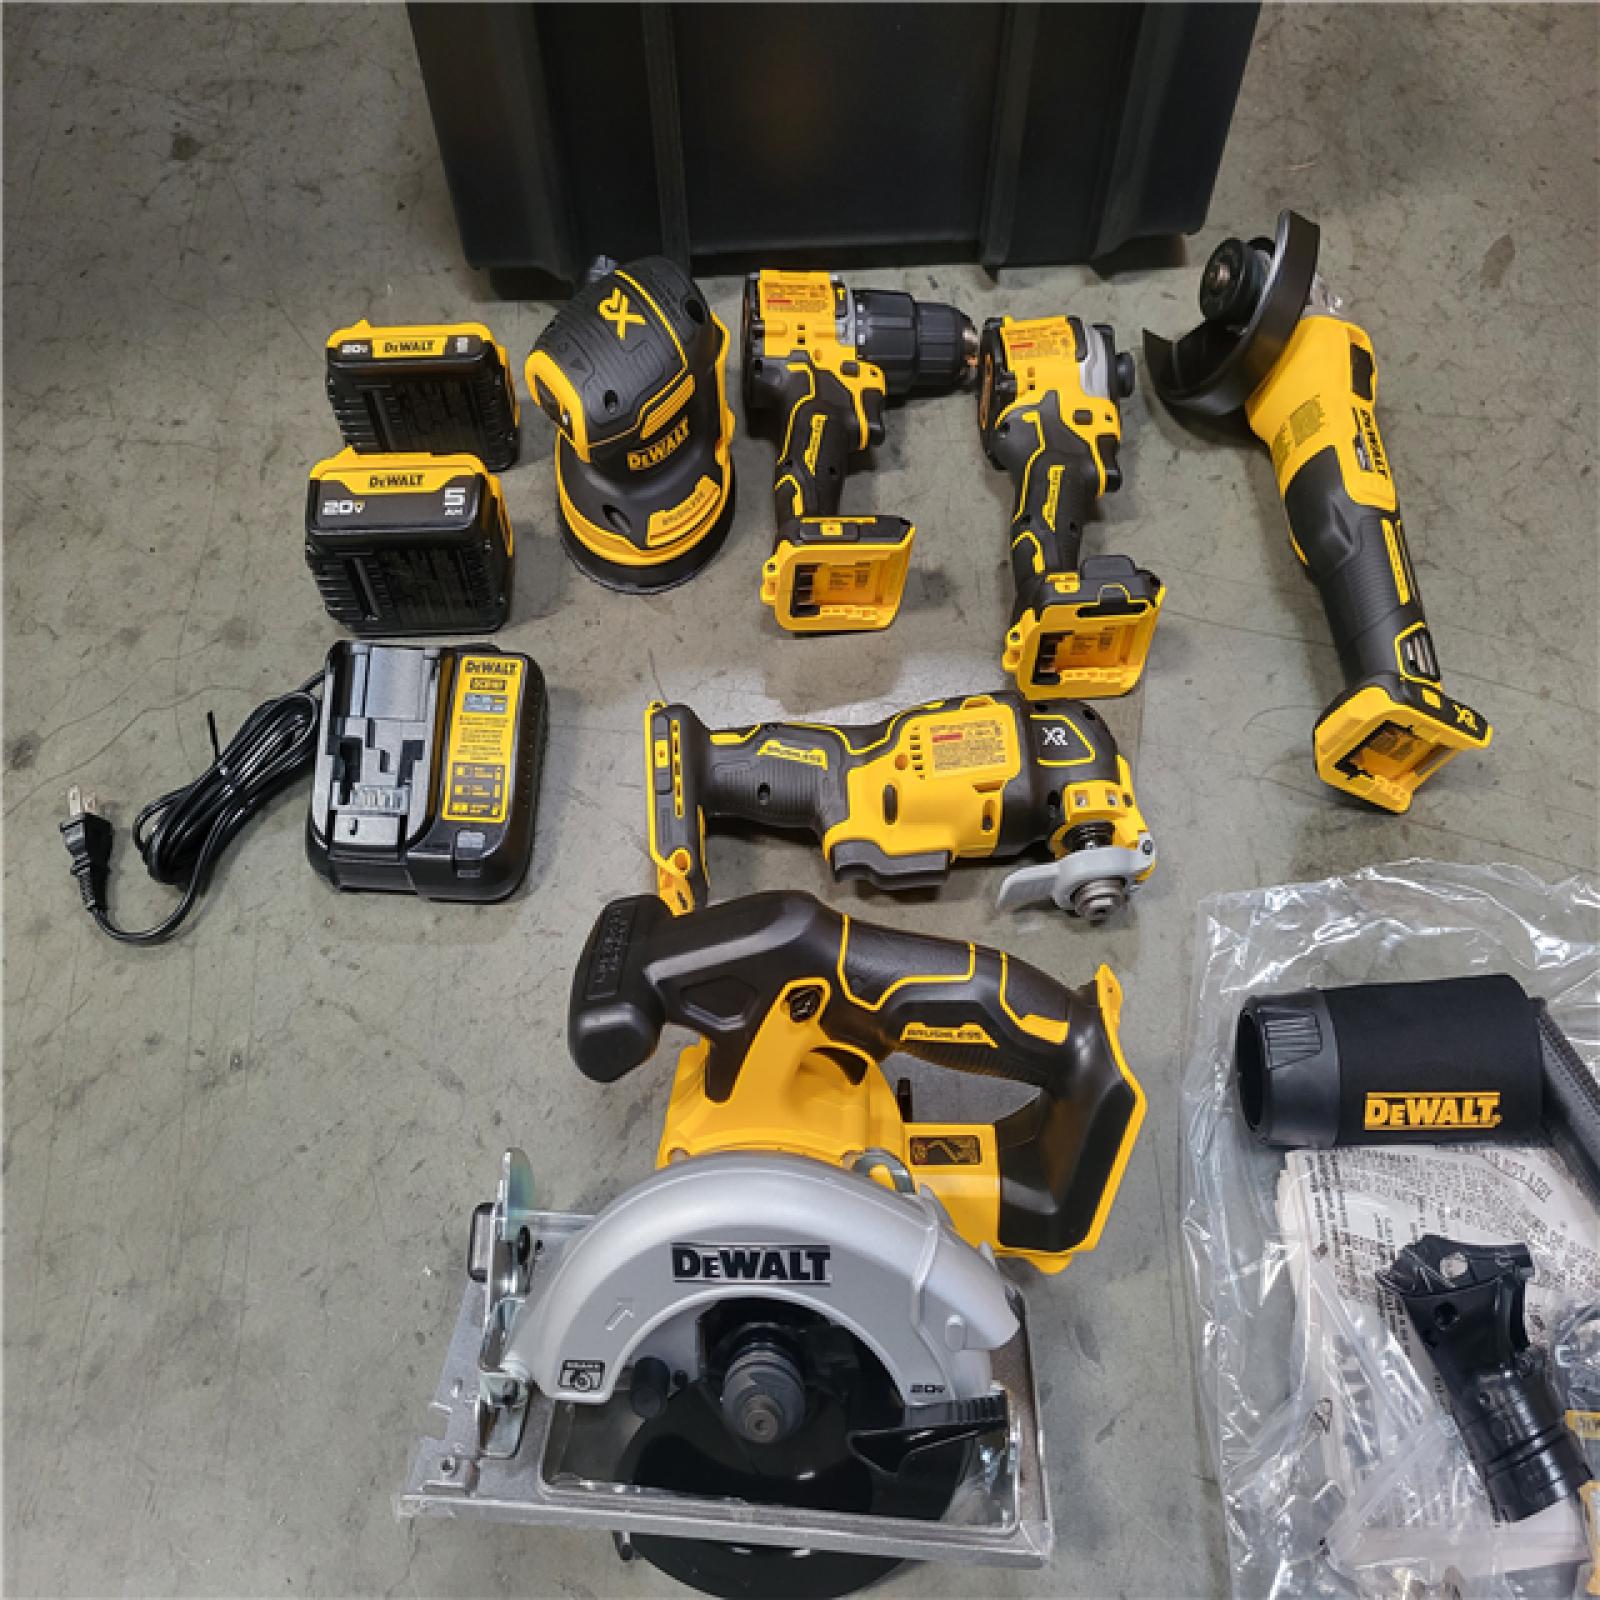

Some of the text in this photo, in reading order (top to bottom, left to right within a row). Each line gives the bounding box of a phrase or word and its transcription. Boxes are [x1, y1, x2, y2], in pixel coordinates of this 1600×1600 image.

[369, 474, 425, 489] DEWALT
[1042, 726, 1068, 746] XR
[1364, 1096, 1503, 1126] DEWALT
[675, 1247, 831, 1280] DEWALT
